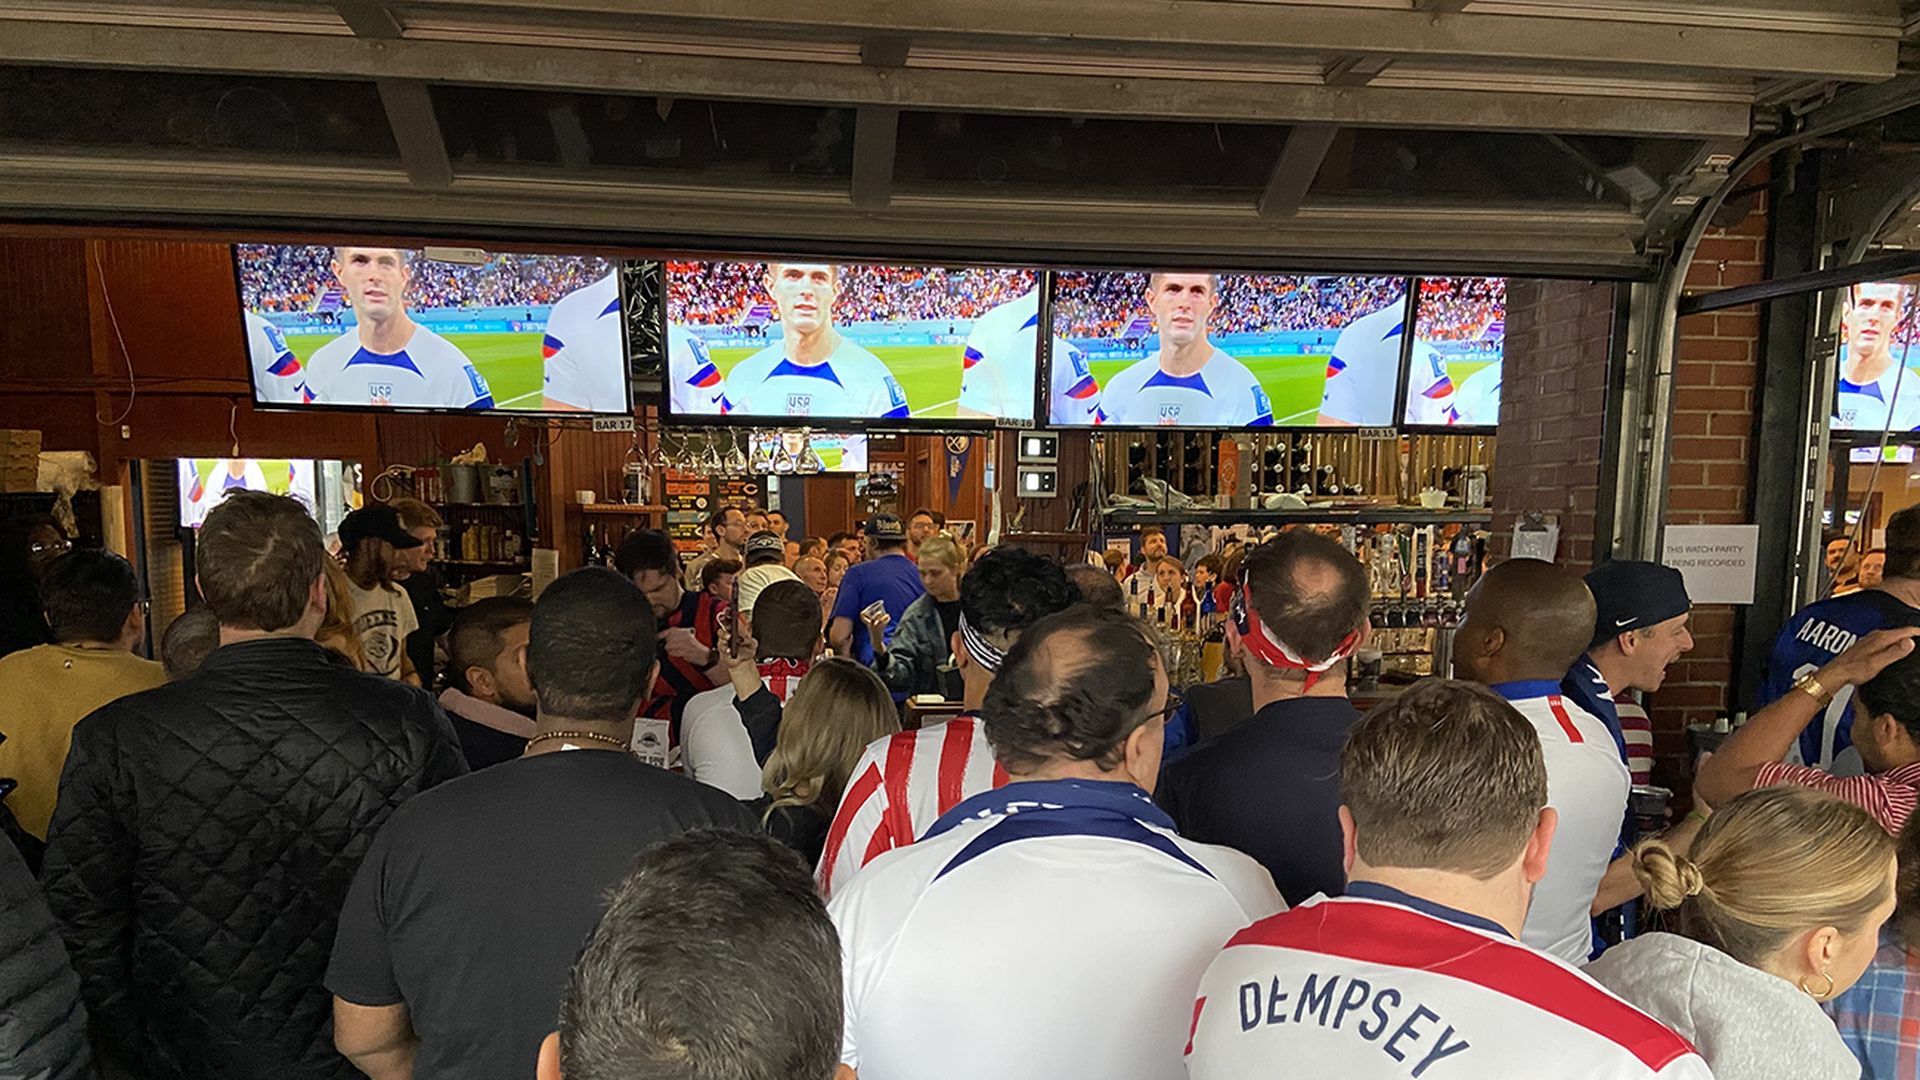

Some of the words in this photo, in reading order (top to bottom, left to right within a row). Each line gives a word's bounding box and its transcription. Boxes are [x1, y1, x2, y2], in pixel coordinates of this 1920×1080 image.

[595, 420, 617, 430] BAR
[620, 420, 632, 430] 17
[998, 418, 1018, 427] BAR
[1360, 429, 1381, 438] BAR
[1382, 429, 1395, 438] 15
[1666, 545, 1684, 554] THIS
[1685, 545, 1714, 554] WATCH
[1715, 545, 1744, 554] PARTY
[1672, 559, 1696, 568] BEING
[1697, 559, 1746, 567] RECORDED
[1239, 973, 1471, 1079] DEMPSEY
